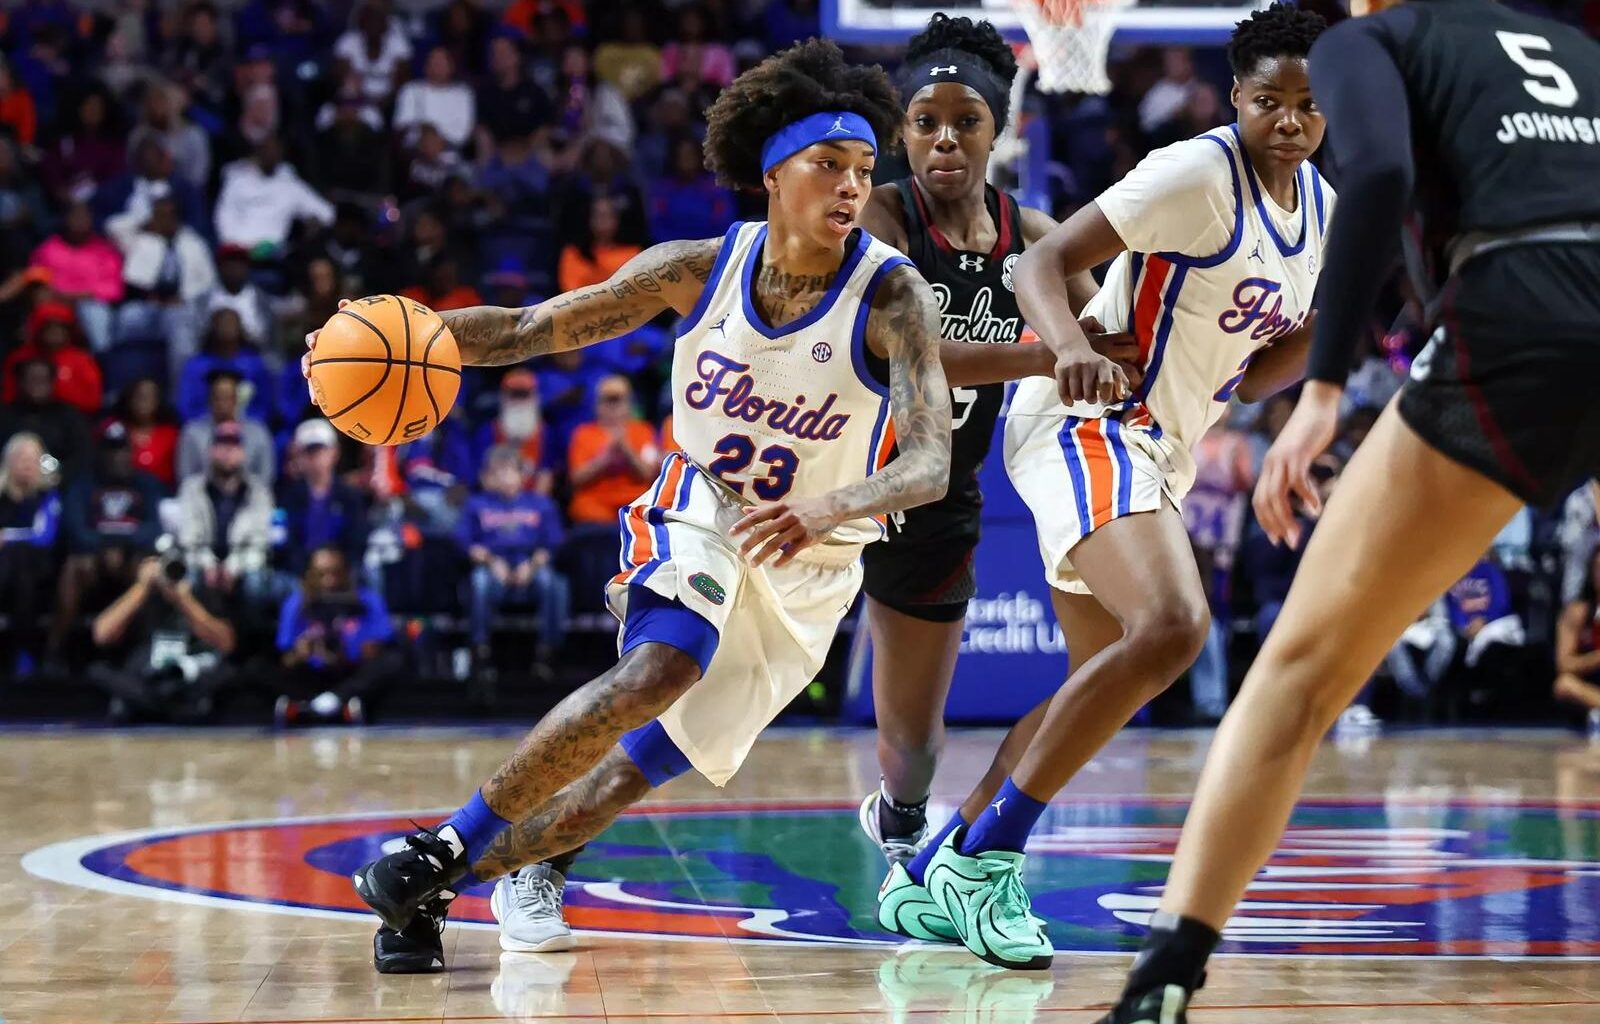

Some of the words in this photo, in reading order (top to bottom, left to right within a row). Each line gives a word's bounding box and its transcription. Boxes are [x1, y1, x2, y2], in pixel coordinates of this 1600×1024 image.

[1494, 29, 1579, 108] 5
[812, 342, 832, 363] SEC
[685, 349, 851, 441] Florida
[708, 432, 801, 502] 23
[959, 620, 1036, 654] redit
